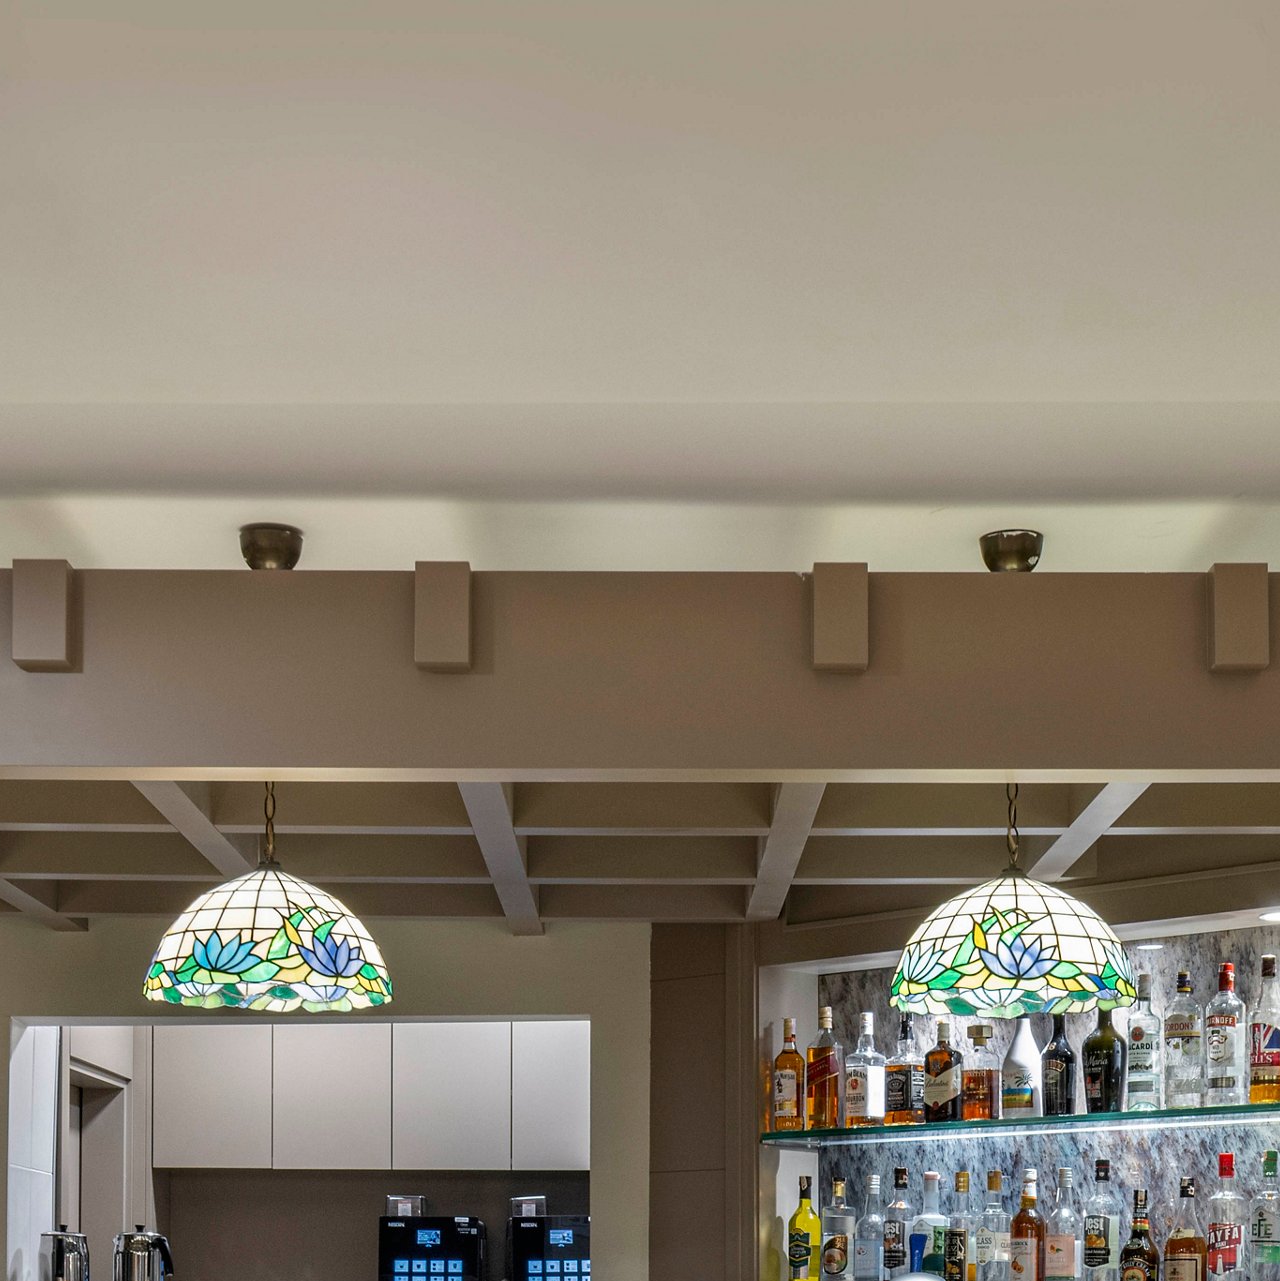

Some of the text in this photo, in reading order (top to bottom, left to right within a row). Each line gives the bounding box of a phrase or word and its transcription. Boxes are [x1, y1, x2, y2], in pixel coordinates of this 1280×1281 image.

[1208, 1016, 1233, 1025] IRNOFF
[1128, 1042, 1153, 1051] ACARDÍ
[1250, 1052, 1273, 1064] ELL'S
[1251, 1217, 1273, 1240] EFE
[1209, 1225, 1239, 1245] AYFA
